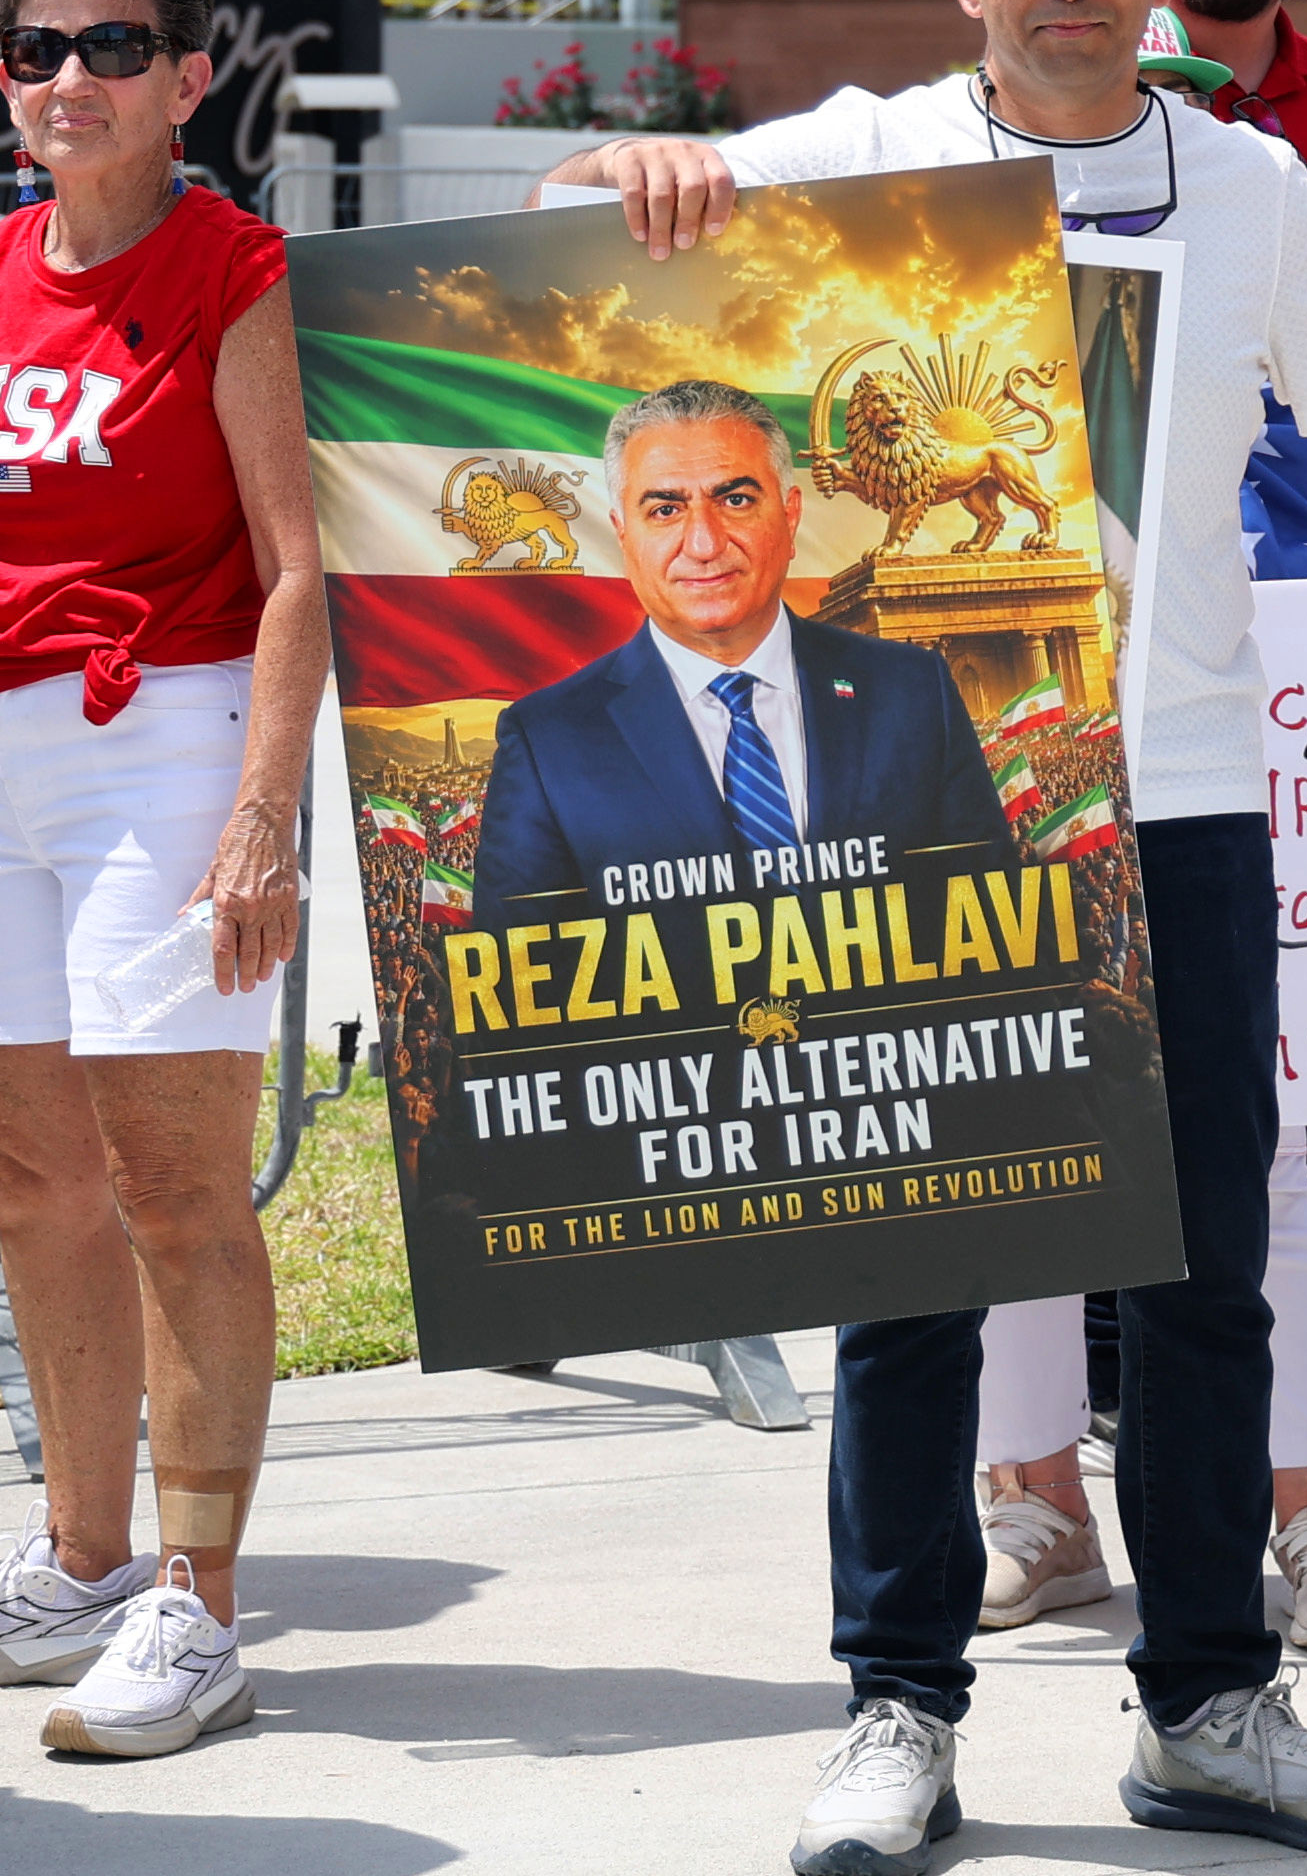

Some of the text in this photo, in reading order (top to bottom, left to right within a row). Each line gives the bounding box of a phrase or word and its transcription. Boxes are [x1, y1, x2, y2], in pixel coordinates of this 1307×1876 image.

[0, 364, 122, 467] SA
[603, 835, 889, 906] CROWN PRINCE
[444, 862, 1080, 1034] REZA PAHLAVI
[463, 1007, 1091, 1140] THE ONLY ALTERNATIVE
[639, 1098, 932, 1184] FOR IRAN
[484, 1153, 1103, 1256] FOR THE LION AND SUN REVOLUTION
